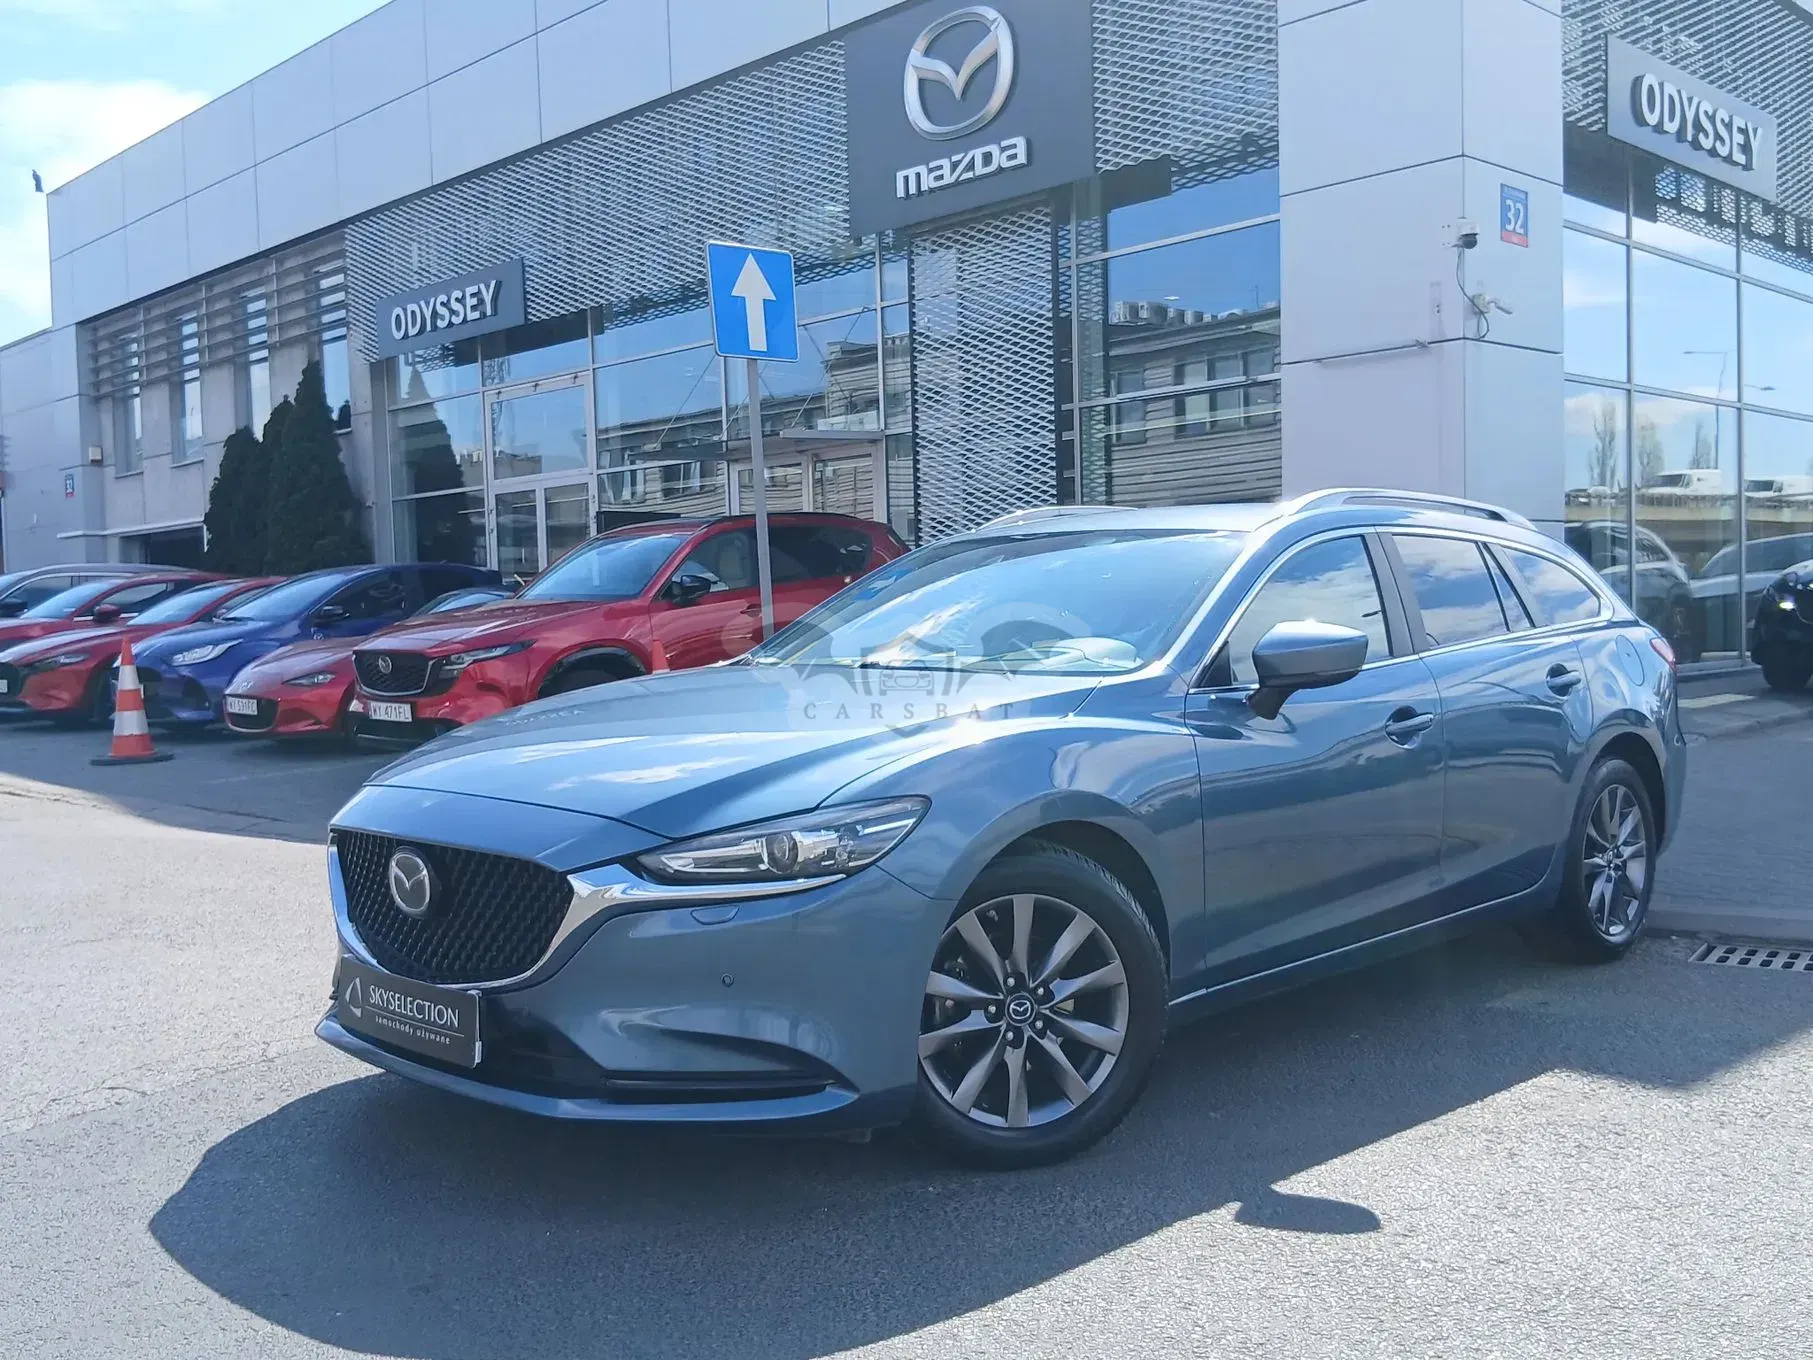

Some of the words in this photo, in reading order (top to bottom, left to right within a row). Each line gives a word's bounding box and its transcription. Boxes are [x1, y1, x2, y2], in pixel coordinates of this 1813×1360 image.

[1641, 73, 1763, 170] ODYSSEY
[896, 136, 1028, 198] mazda
[1505, 199, 1525, 235] 32
[391, 279, 498, 340] ODYSSEY
[369, 985, 460, 1028] SKYSELECTION
[375, 1015, 414, 1035] samochody
